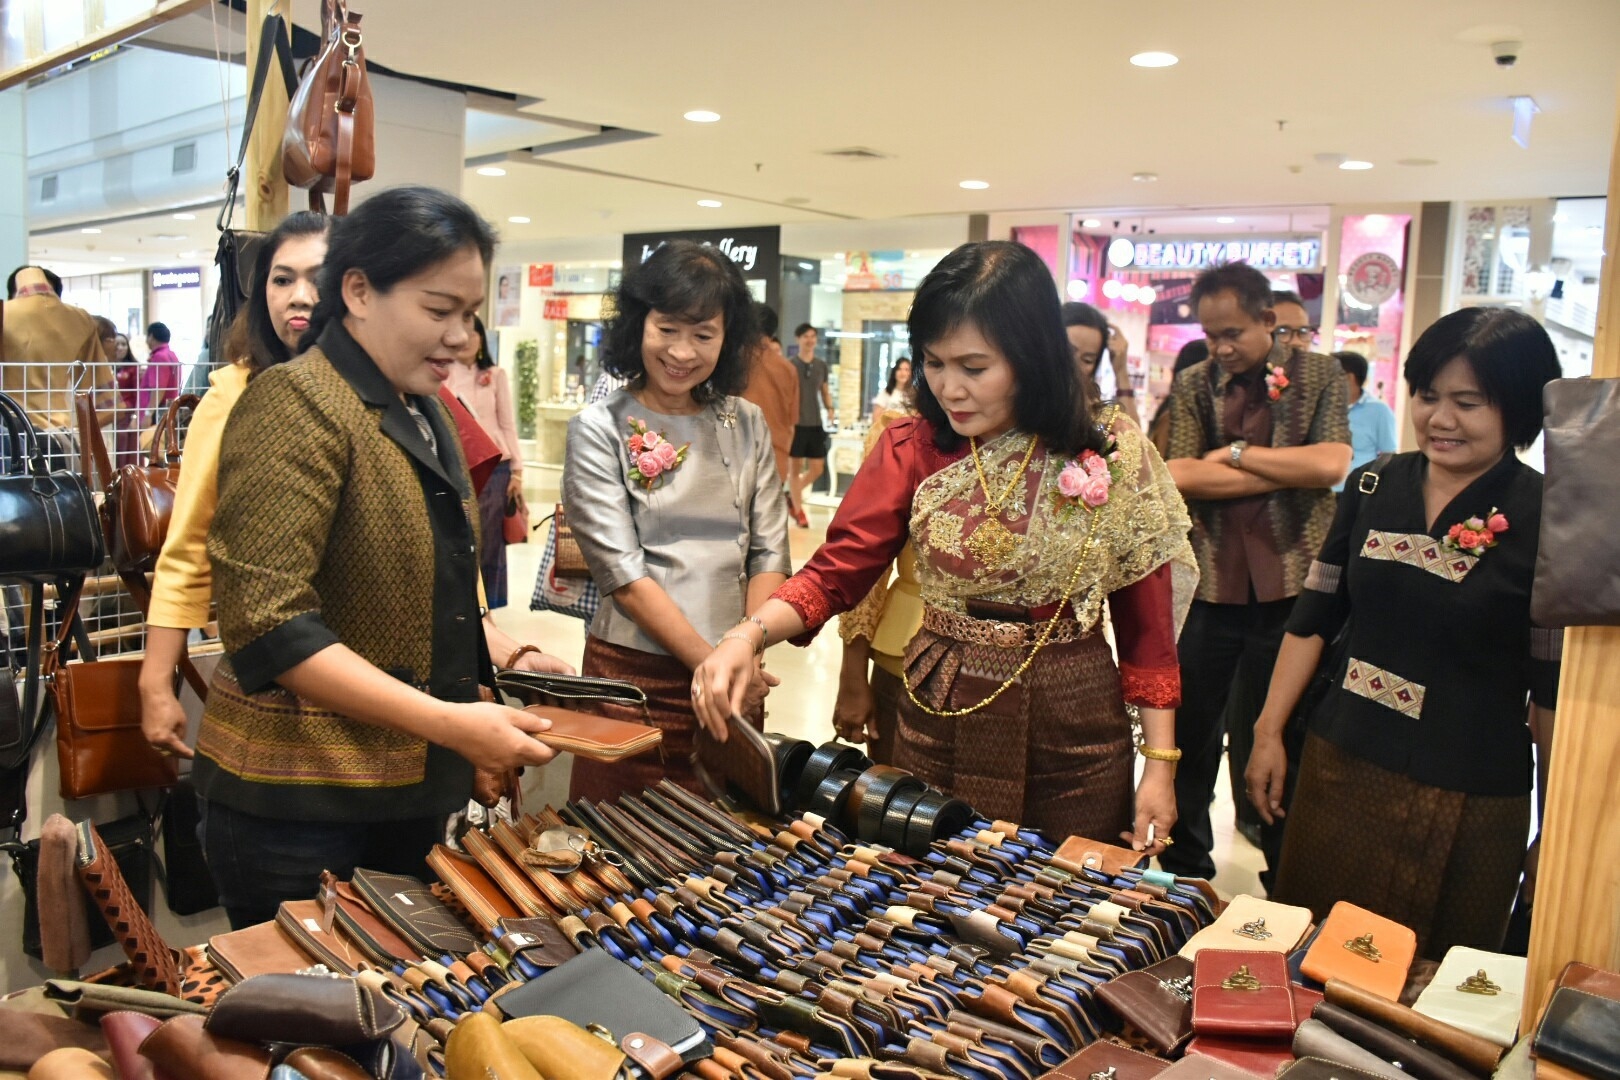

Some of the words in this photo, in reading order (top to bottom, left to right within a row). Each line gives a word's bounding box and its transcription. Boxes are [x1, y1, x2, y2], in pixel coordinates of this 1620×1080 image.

[702, 237, 758, 271] llery
[1134, 242, 1222, 267] BEAUTY
[1225, 241, 1316, 267] BUFFET
